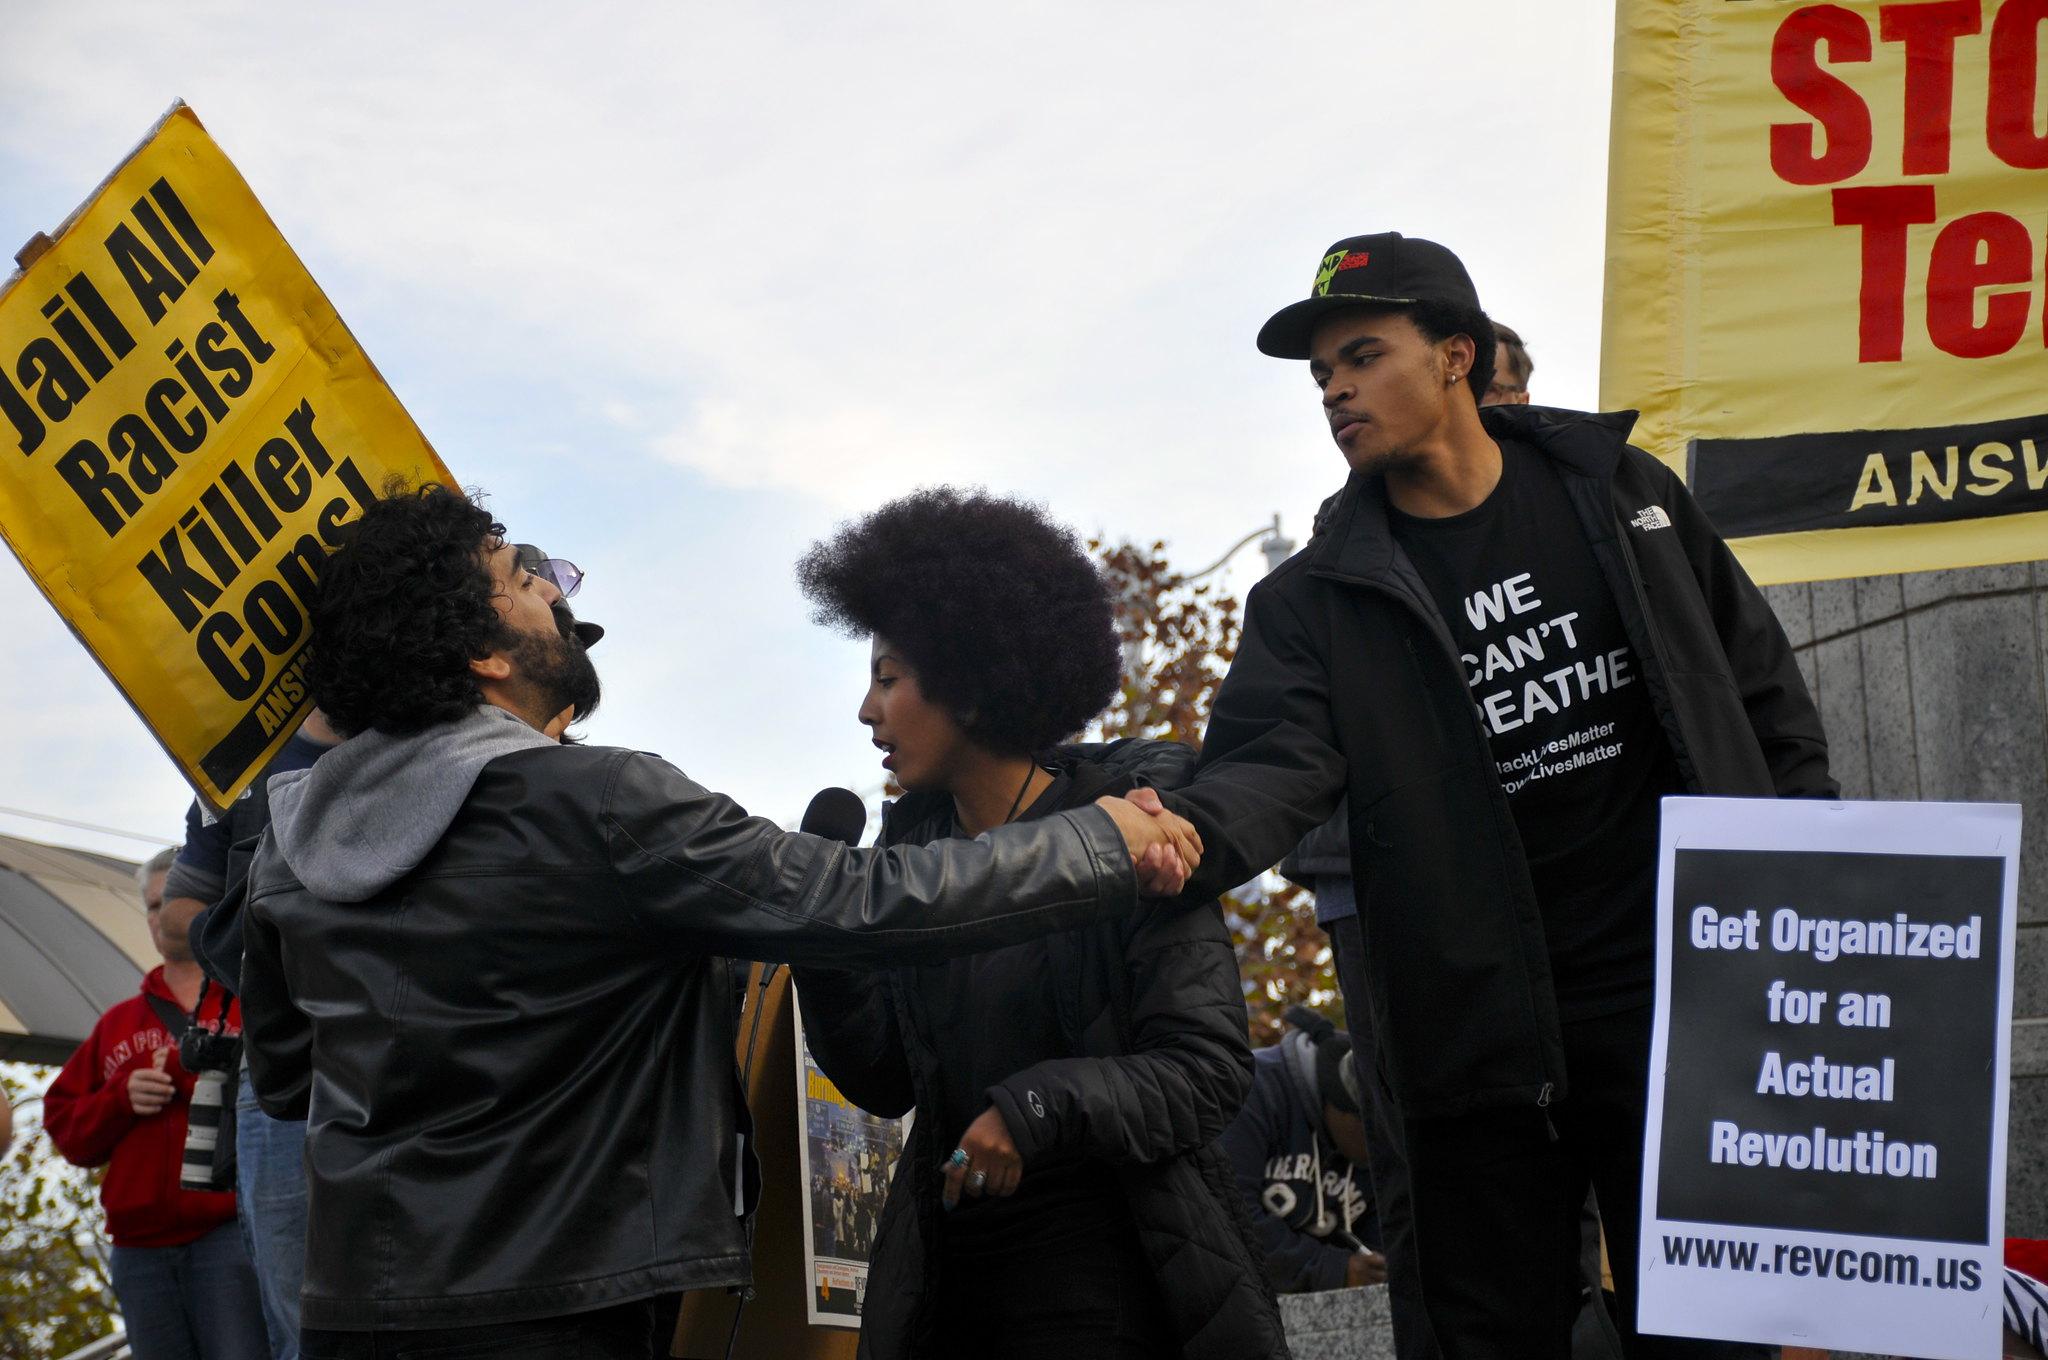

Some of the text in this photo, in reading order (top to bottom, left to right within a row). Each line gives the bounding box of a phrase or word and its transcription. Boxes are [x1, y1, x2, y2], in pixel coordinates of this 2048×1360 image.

[1831, 185, 2048, 363] Te
[0, 176, 215, 457] Jail All
[54, 288, 276, 538] Racist
[136, 396, 335, 633] Killer
[1631, 513, 1658, 528] NORTH
[1637, 506, 1654, 517] THE
[1642, 520, 1662, 532] FACE
[1464, 572, 1542, 631] WE
[1691, 905, 1982, 962] Get Organized
[1768, 980, 1892, 1028] for an
[1756, 1052, 1895, 1102] Actual
[1711, 1121, 1938, 1180] Revolution
[1661, 1235, 1983, 1292] www.revcom.us
